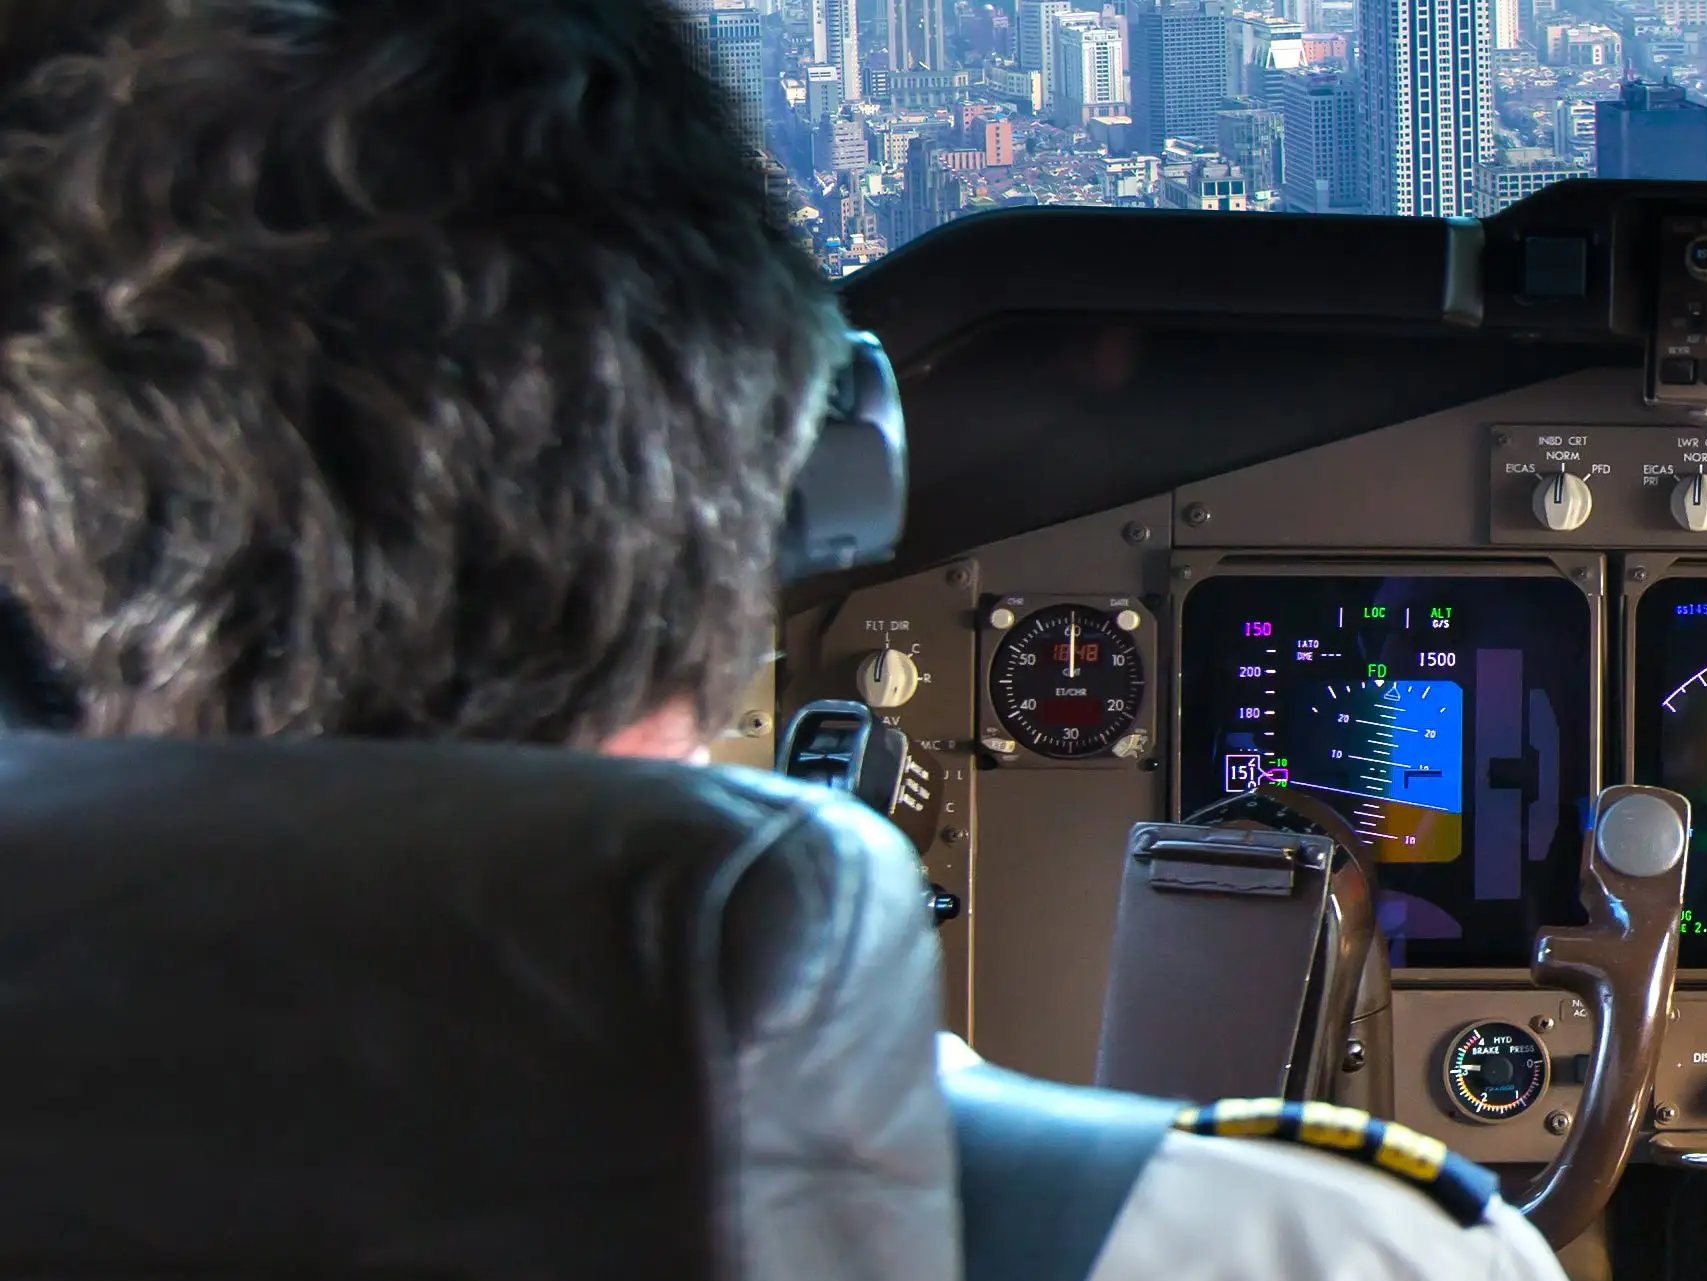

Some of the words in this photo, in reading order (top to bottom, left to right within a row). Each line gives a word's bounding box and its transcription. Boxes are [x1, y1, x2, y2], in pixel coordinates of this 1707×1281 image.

[1677, 437, 1700, 448] LWR
[1546, 450, 1581, 461] NORM
[1243, 621, 1272, 637] 150
[1419, 651, 1456, 667] 1500
[1367, 663, 1387, 678] FD
